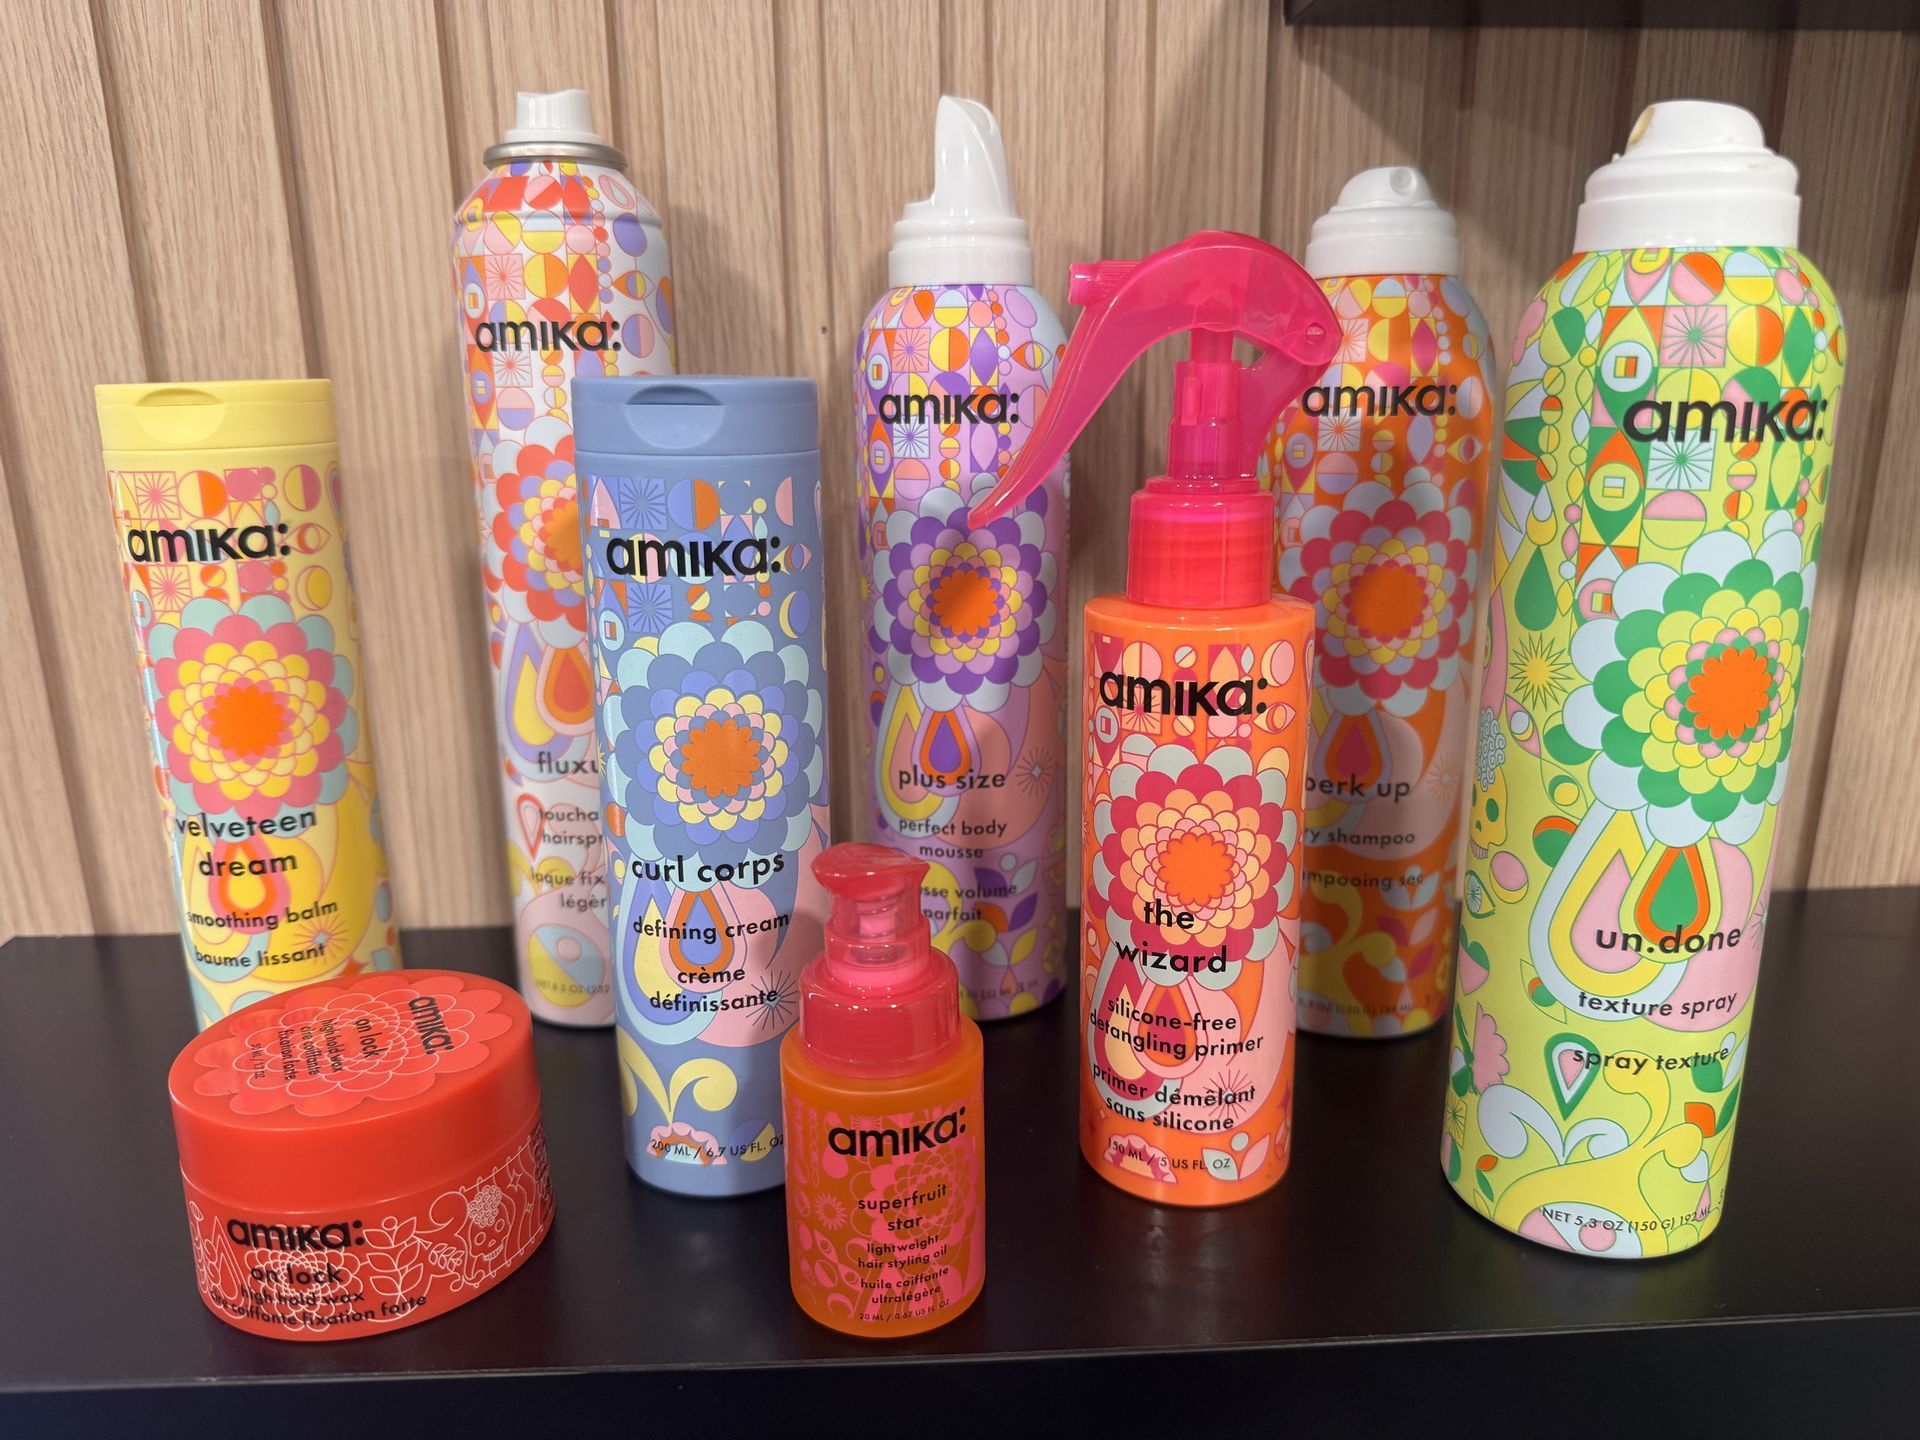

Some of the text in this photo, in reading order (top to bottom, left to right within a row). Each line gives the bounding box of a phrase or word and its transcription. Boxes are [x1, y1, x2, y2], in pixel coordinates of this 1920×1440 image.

[476, 320, 622, 353] amika:
[879, 393, 1020, 425] amika:
[1302, 384, 1458, 417] amika:
[1623, 399, 1828, 443] amika:
[127, 523, 291, 563] amika:
[606, 536, 781, 577] amika:
[1100, 671, 1268, 717] amika:
[538, 750, 599, 774] fluxu
[899, 765, 1006, 790] plus size
[1376, 781, 1410, 802] up
[176, 811, 317, 838] velveteen
[540, 806, 599, 821] toucha
[542, 829, 604, 848] hairspr
[899, 818, 1007, 837] perfect body
[1327, 828, 1415, 849] shampoo
[198, 851, 298, 877] dream
[919, 845, 984, 859] mousse
[531, 866, 605, 888] laque fix
[632, 853, 785, 885] curl corps
[1302, 869, 1392, 892] mpooing
[560, 892, 607, 912] légèr
[920, 883, 1017, 899] sse volume
[187, 901, 339, 930] smoothing balm
[1143, 898, 1195, 929] the
[633, 913, 789, 944] defining cream
[1595, 924, 1742, 954] un.done
[194, 943, 325, 967] baume lissant
[1115, 940, 1227, 973] wizard
[677, 966, 746, 984] crème
[650, 990, 779, 1012] définissante
[1108, 997, 1237, 1031] silicone-free
[1578, 991, 1737, 1019] texture spray
[355, 1019, 388, 1059] on lock
[408, 996, 456, 1056] amika:
[1090, 1010, 1264, 1060] detangling primer
[1572, 1047, 1729, 1075] spray texture
[1092, 1064, 1256, 1107] primer démêlant
[1106, 1097, 1235, 1131] sans silicone
[828, 1106, 966, 1157] amika:
[651, 1138, 671, 1153] 200
[674, 1146, 691, 1157] ML
[706, 1146, 726, 1157] 6.7
[730, 1145, 747, 1156] US
[1128, 1148, 1144, 1161] ML
[1160, 1157, 1168, 1167] 5
[1172, 1158, 1189, 1169] US
[1212, 1157, 1231, 1169] OZ
[857, 1183, 948, 1214] superfruit
[887, 1216, 923, 1231] star
[1542, 1205, 1571, 1224] NET
[1574, 1215, 1597, 1229] 5.3
[1602, 1219, 1624, 1231] OZ
[1628, 1219, 1658, 1234] (150
[1661, 1217, 1675, 1230] G)
[227, 1218, 367, 1251] amika:
[866, 1234, 938, 1256] lightweight
[857, 1244, 947, 1270] hair styling oil
[251, 1263, 343, 1285] on lock
[860, 1267, 949, 1289] huile coiffante
[322, 1292, 365, 1305] wax
[381, 1295, 428, 1317] forte
